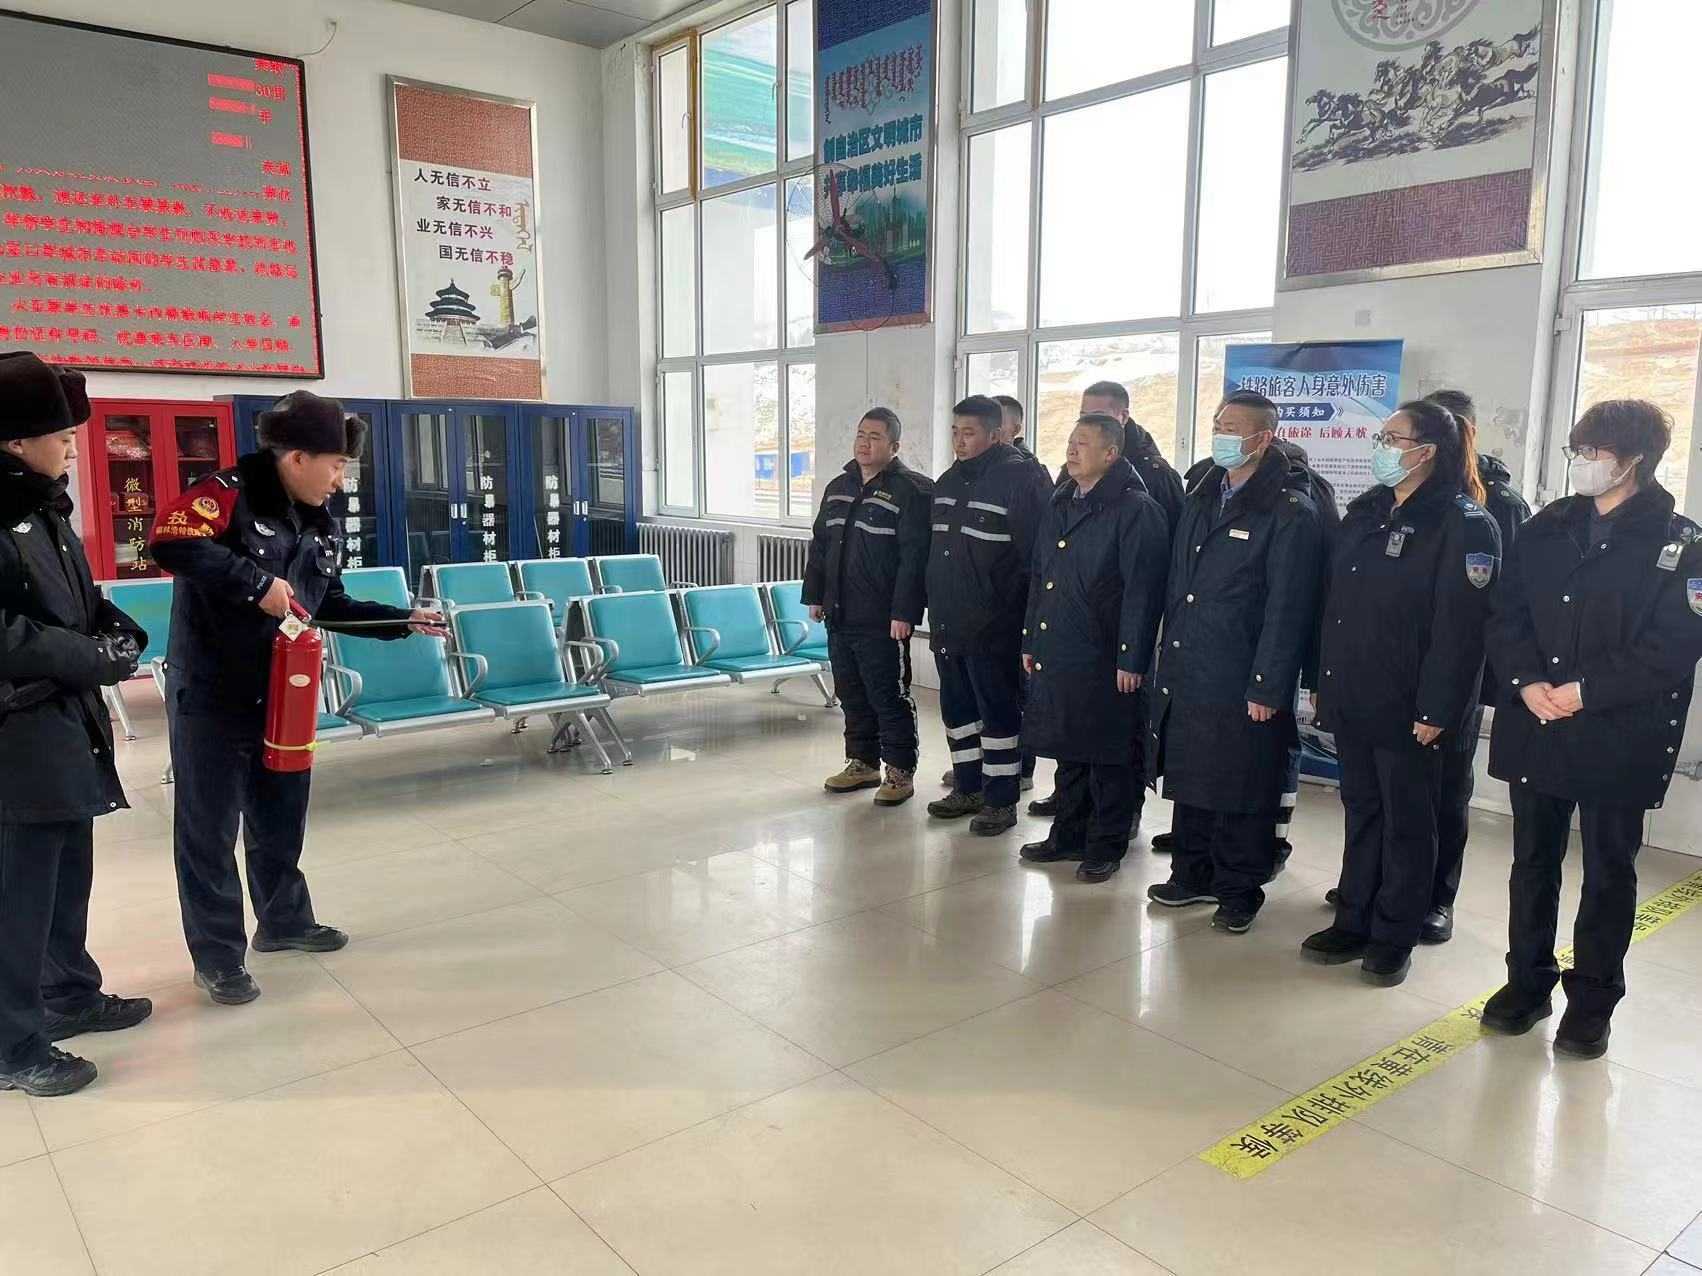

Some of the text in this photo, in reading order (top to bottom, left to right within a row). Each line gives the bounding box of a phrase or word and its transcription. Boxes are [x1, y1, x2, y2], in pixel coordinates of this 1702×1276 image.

[414, 168, 492, 192] 人无信不立
[436, 196, 512, 218] 家无信不和
[416, 218, 494, 240] 业无信不兴
[439, 245, 514, 266] 国无信不稳
[124, 477, 149, 571] 微型消防站
[1231, 1035, 1454, 1158] 请在黄线外排队等候
